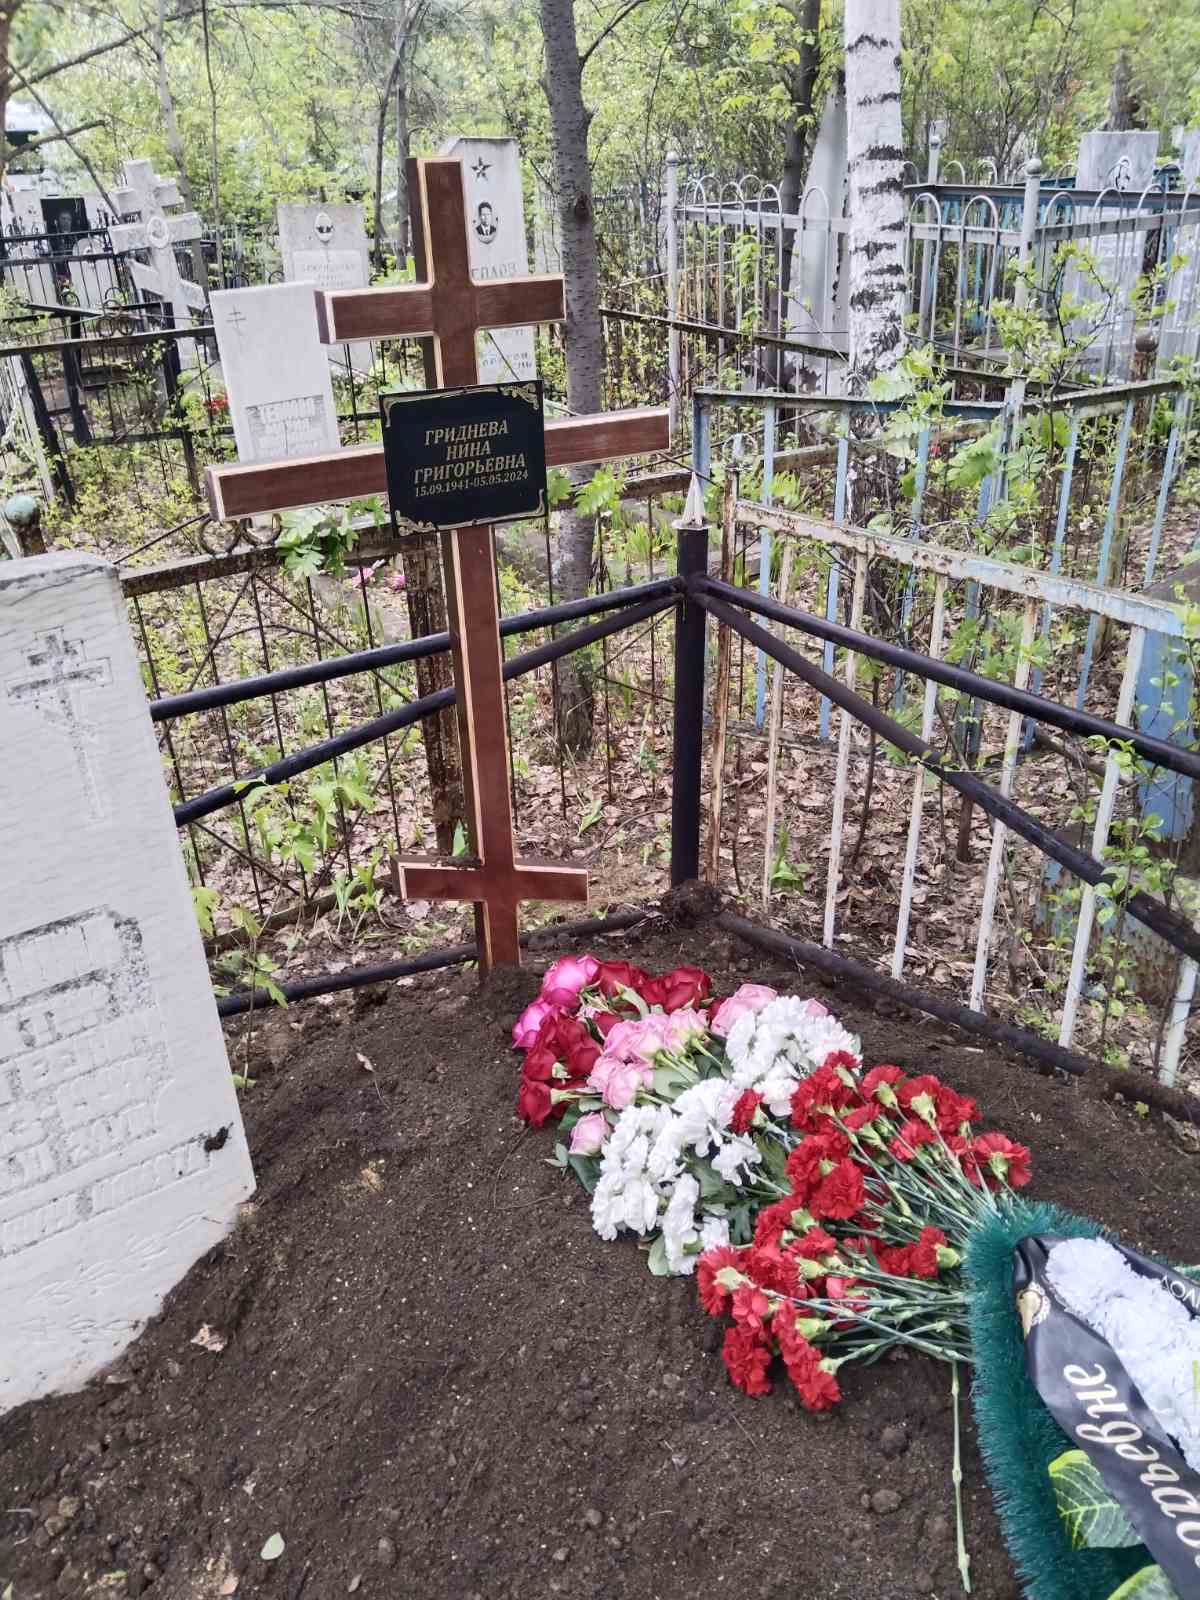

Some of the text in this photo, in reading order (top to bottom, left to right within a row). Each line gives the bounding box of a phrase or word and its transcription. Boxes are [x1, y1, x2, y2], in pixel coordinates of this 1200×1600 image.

[424, 419, 509, 446] ГРИДНЕВА
[446, 440, 491, 461] НИНА
[414, 453, 526, 484] ГРИГОРЬЕВНА
[415, 469, 528, 497] 15.09.1941-05.05.2024
[1063, 1363, 1200, 1569] орьевне
